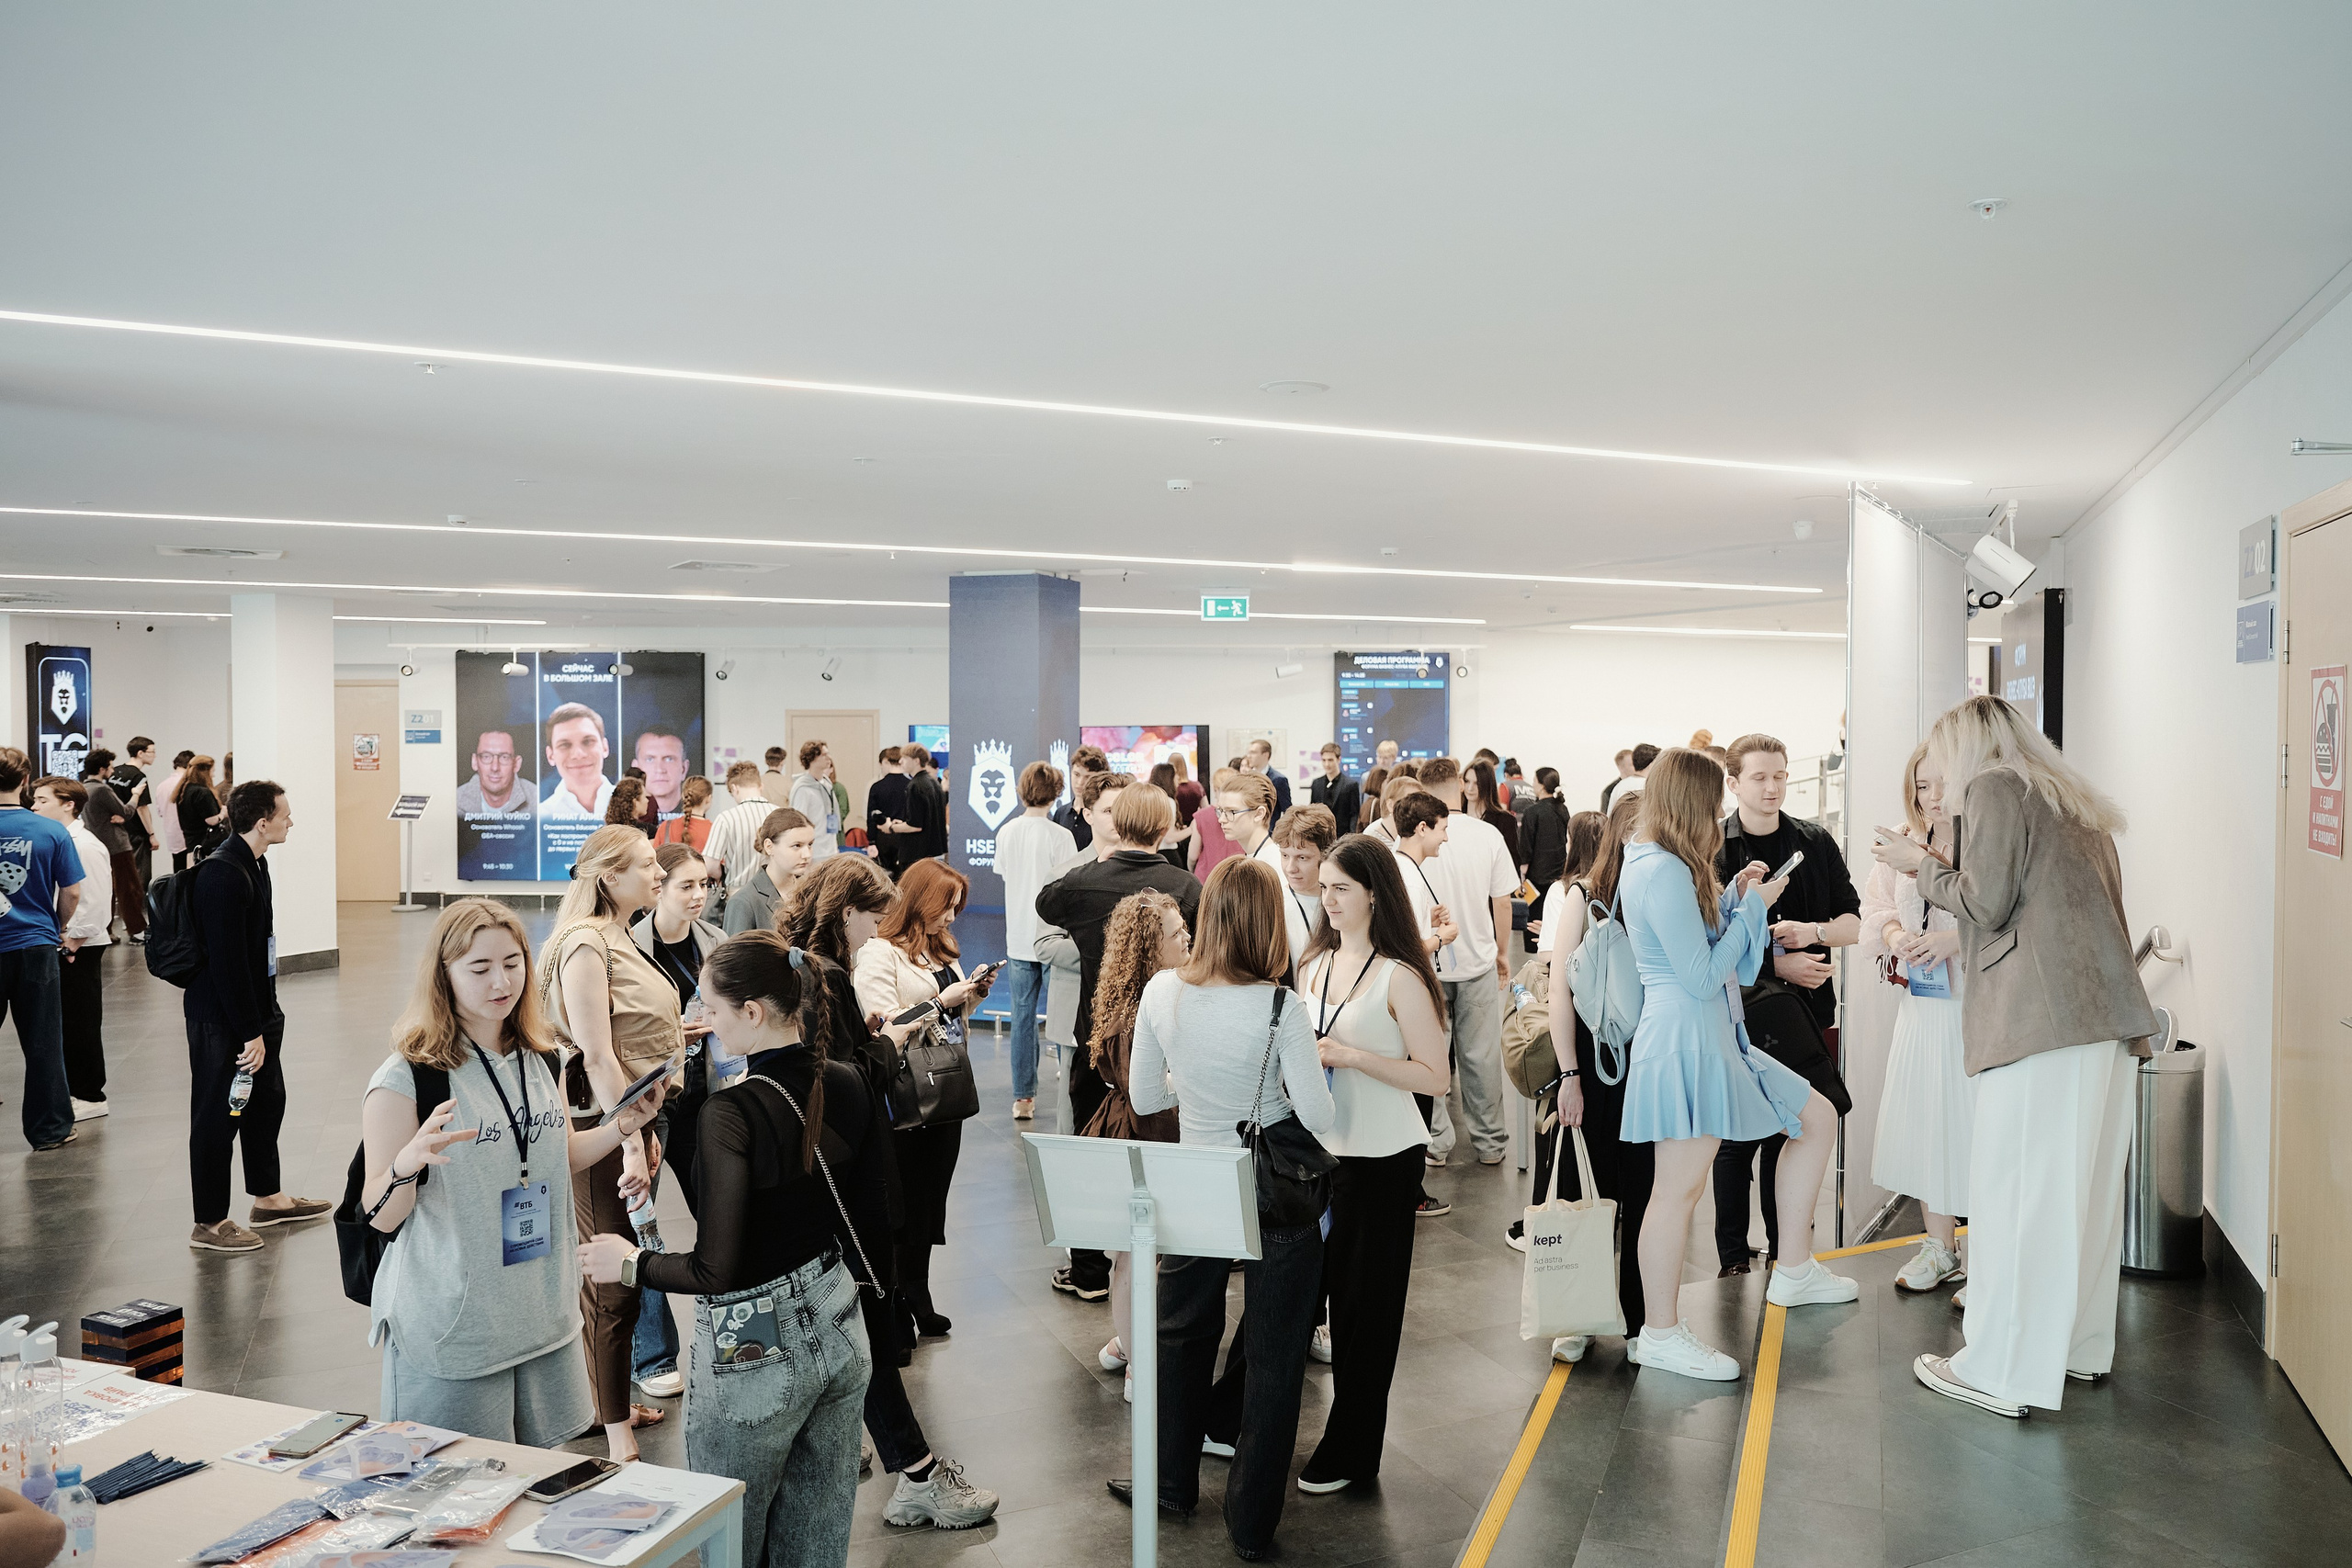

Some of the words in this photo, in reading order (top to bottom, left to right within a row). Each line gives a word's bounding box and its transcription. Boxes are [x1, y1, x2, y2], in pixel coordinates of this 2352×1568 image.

[561, 663, 594, 673] СЕЙЧАС
[411, 714, 434, 724] Z201
[464, 811, 503, 821] ДМИТРИЙ
[504, 811, 531, 820] ЧУЙКО
[966, 839, 995, 854] HSE
[476, 1116, 501, 1145] Los
[520, 1201, 533, 1210] ВТБ
[1533, 1234, 1562, 1247] kept
[1547, 1263, 1578, 1271] business
